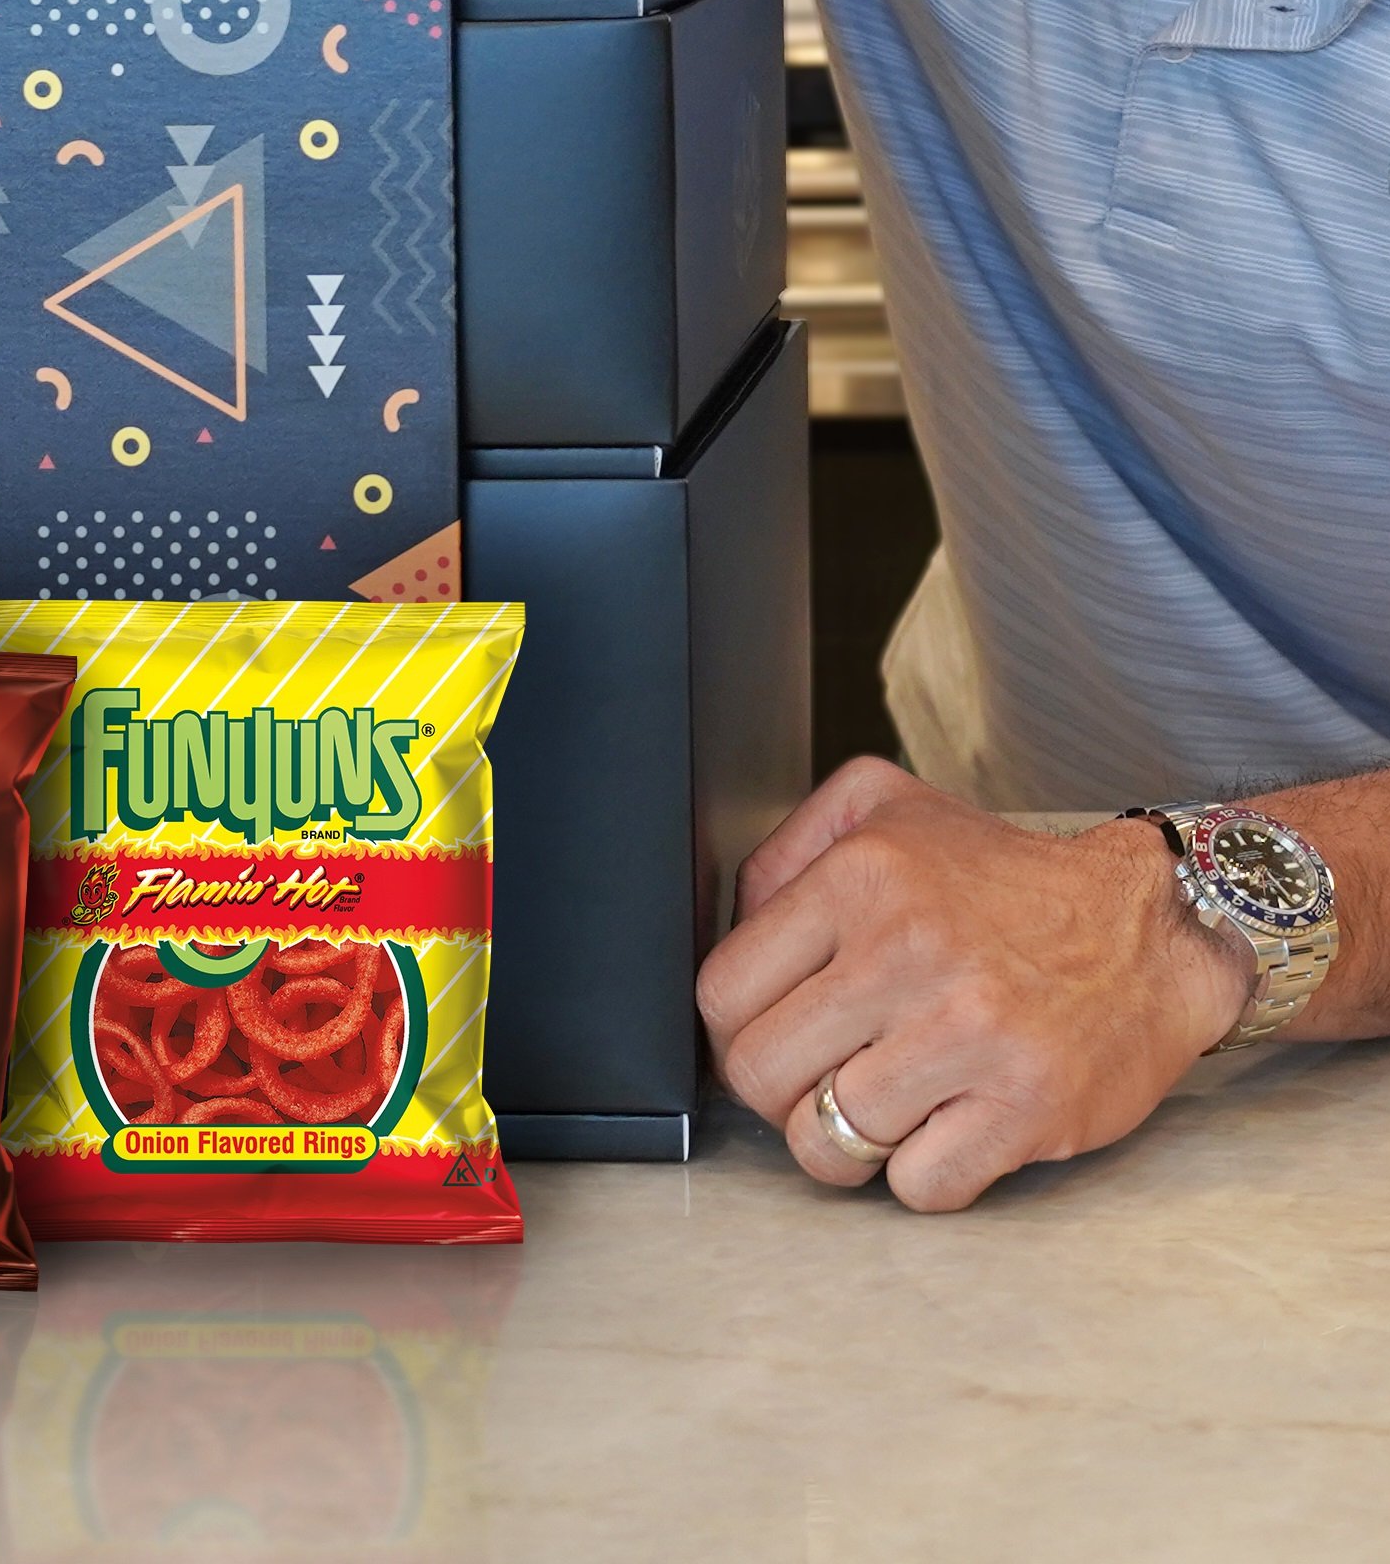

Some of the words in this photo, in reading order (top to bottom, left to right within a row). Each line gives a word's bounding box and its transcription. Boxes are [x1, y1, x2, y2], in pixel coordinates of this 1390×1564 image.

[300, 829, 341, 841] BRAND
[121, 863, 276, 918] Flamin'
[276, 865, 362, 912] Hot
[338, 895, 361, 905] Brand
[333, 904, 356, 913] Flavor
[124, 1130, 190, 1155] Onion
[198, 1130, 296, 1155] Flavored
[303, 1130, 367, 1159] Rings
[456, 1167, 468, 1183] K
